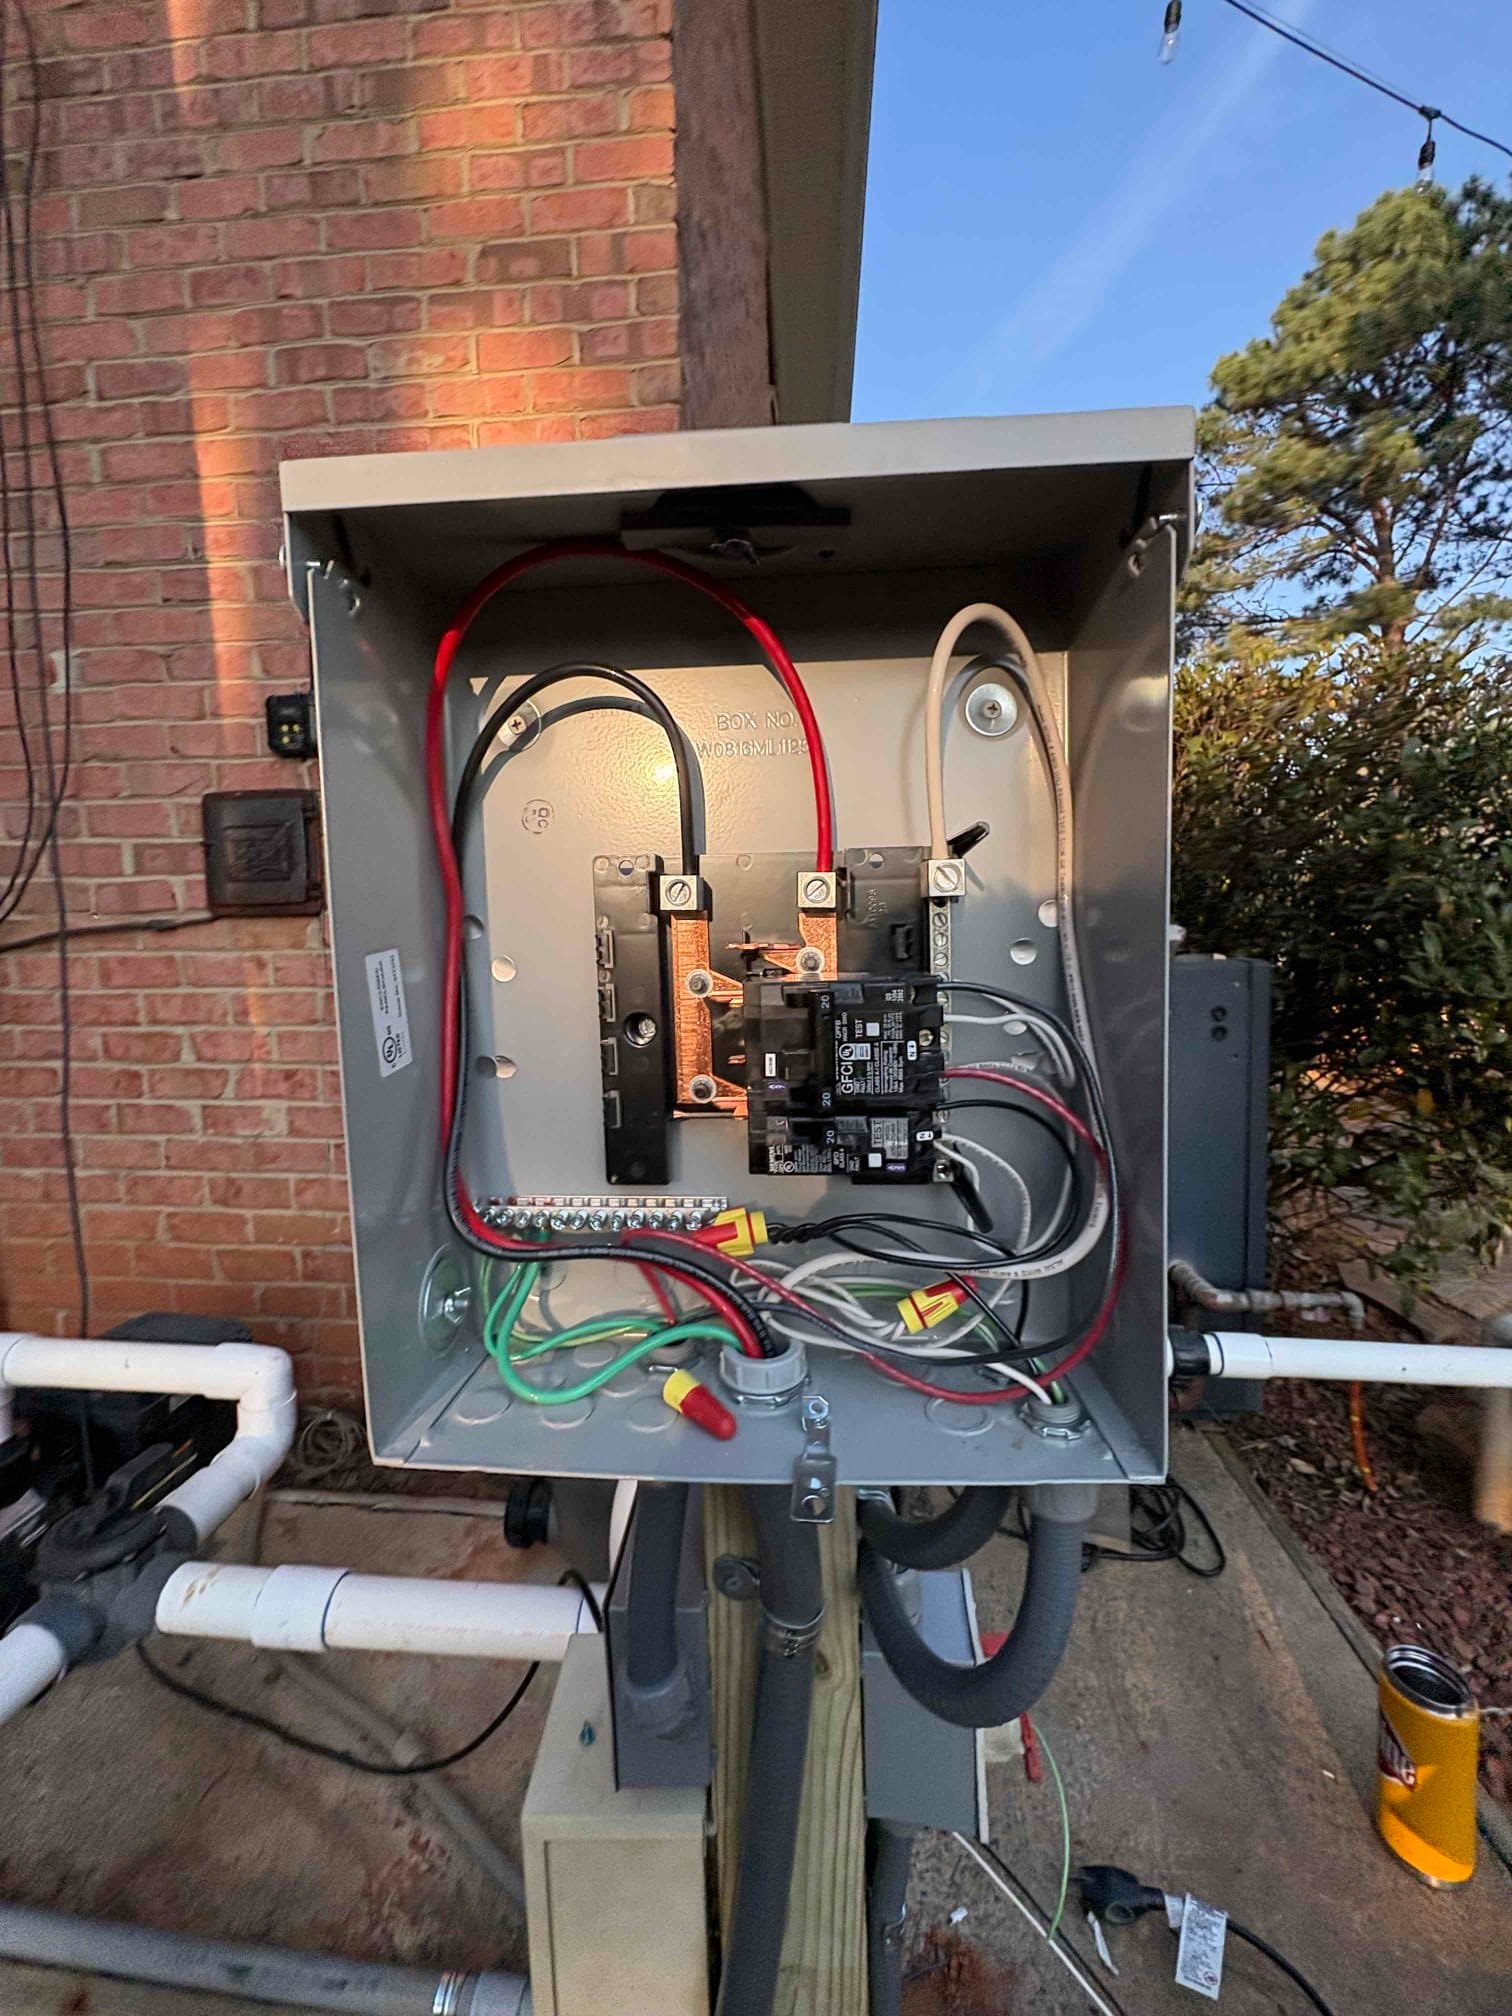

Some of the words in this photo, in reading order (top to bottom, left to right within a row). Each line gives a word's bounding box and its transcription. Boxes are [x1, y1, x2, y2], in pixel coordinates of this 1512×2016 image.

[717, 711, 757, 731] BOX
[766, 711, 798, 729] NO.
[821, 995, 830, 1009] 20
[855, 1019, 863, 1038] TEST
[841, 1062, 853, 1094] GFCI
[822, 1092, 831, 1107] 20
[826, 1130, 835, 1144] 20
[873, 1119, 882, 1144] TEST
